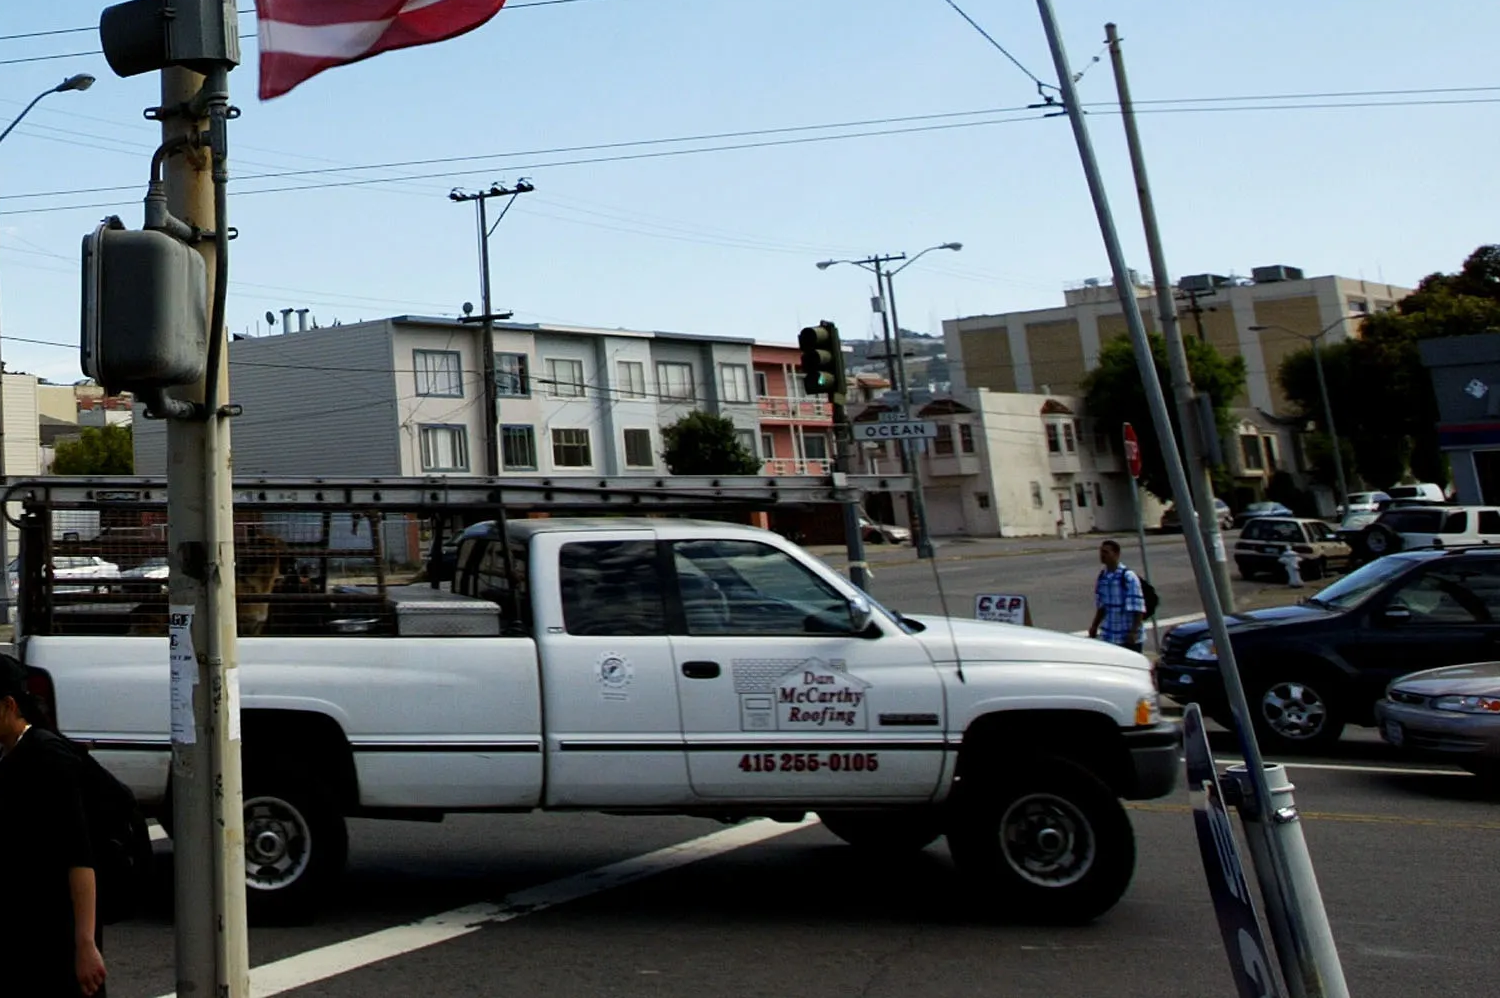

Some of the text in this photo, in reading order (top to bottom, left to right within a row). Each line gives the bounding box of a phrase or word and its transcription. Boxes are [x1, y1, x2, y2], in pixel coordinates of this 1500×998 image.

[865, 424, 925, 437] OCEAN
[803, 671, 835, 685] Dan
[778, 687, 863, 707] McCarthy
[788, 706, 856, 726] Roofing
[738, 753, 879, 772] 415 255-0105
